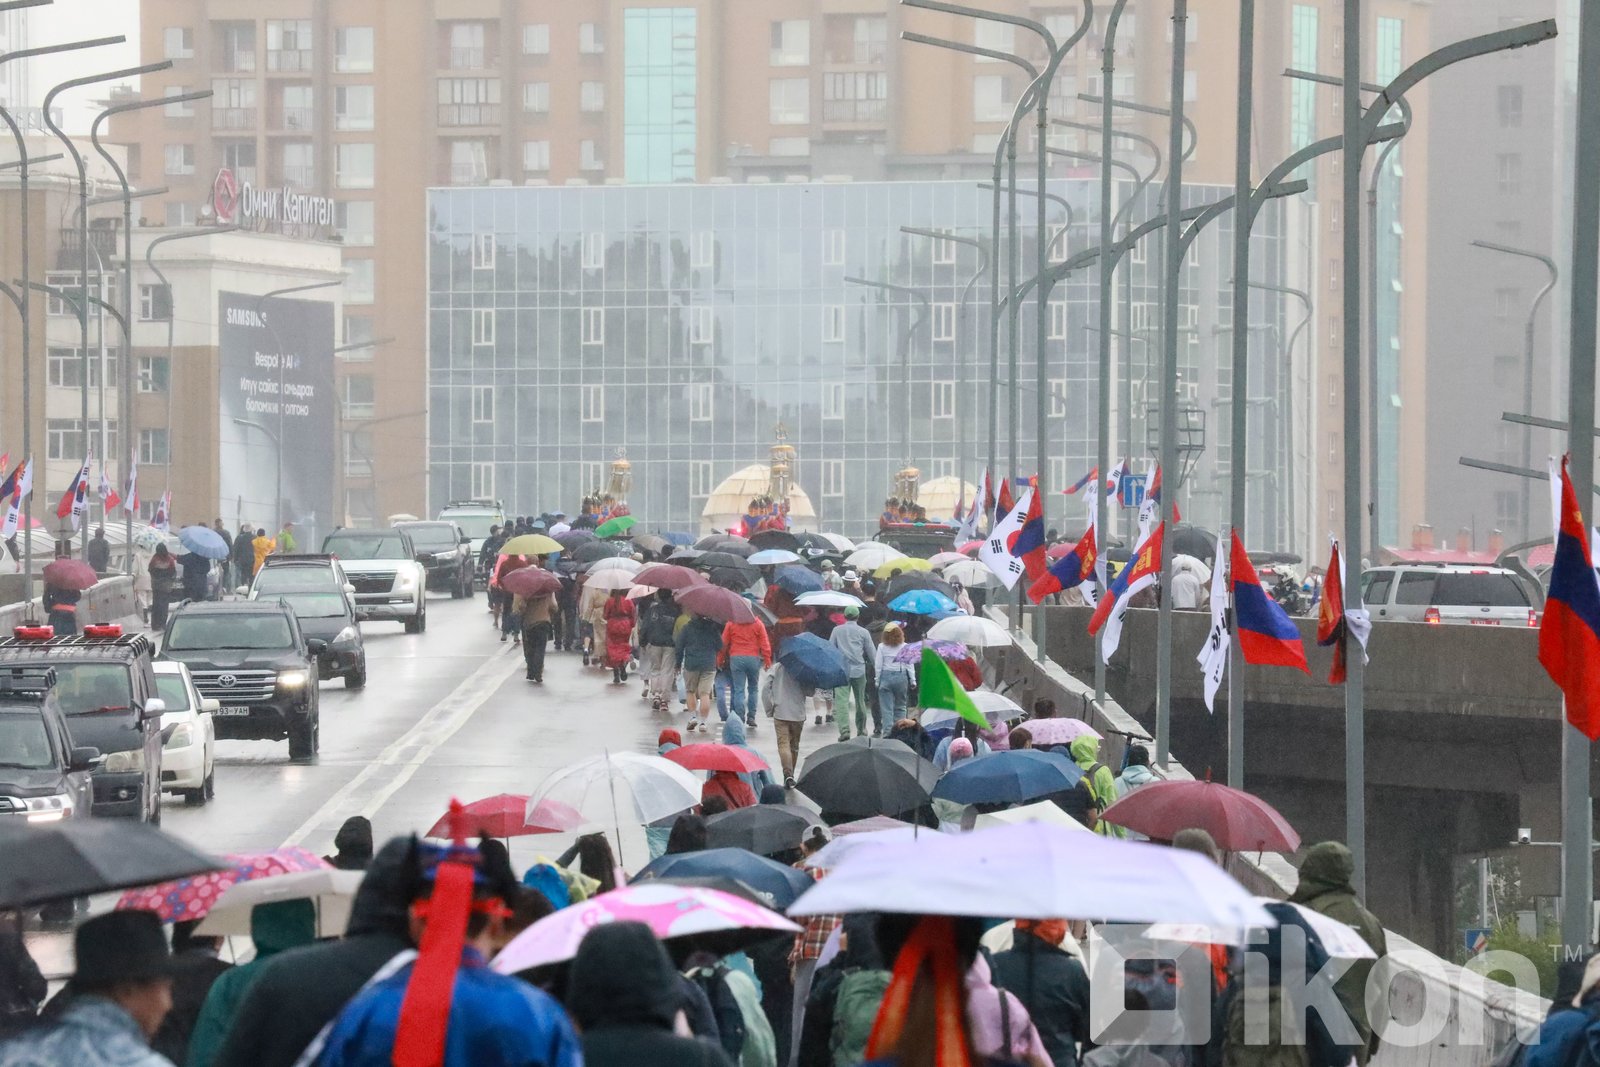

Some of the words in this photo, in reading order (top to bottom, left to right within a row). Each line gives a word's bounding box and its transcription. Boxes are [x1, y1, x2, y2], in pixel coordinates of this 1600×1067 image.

[242, 181, 277, 219] Омни
[283, 186, 335, 225] Капитал
[286, 354, 294, 369] AI
[284, 383, 314, 401] амьдрах
[285, 403, 310, 417] олгоно
